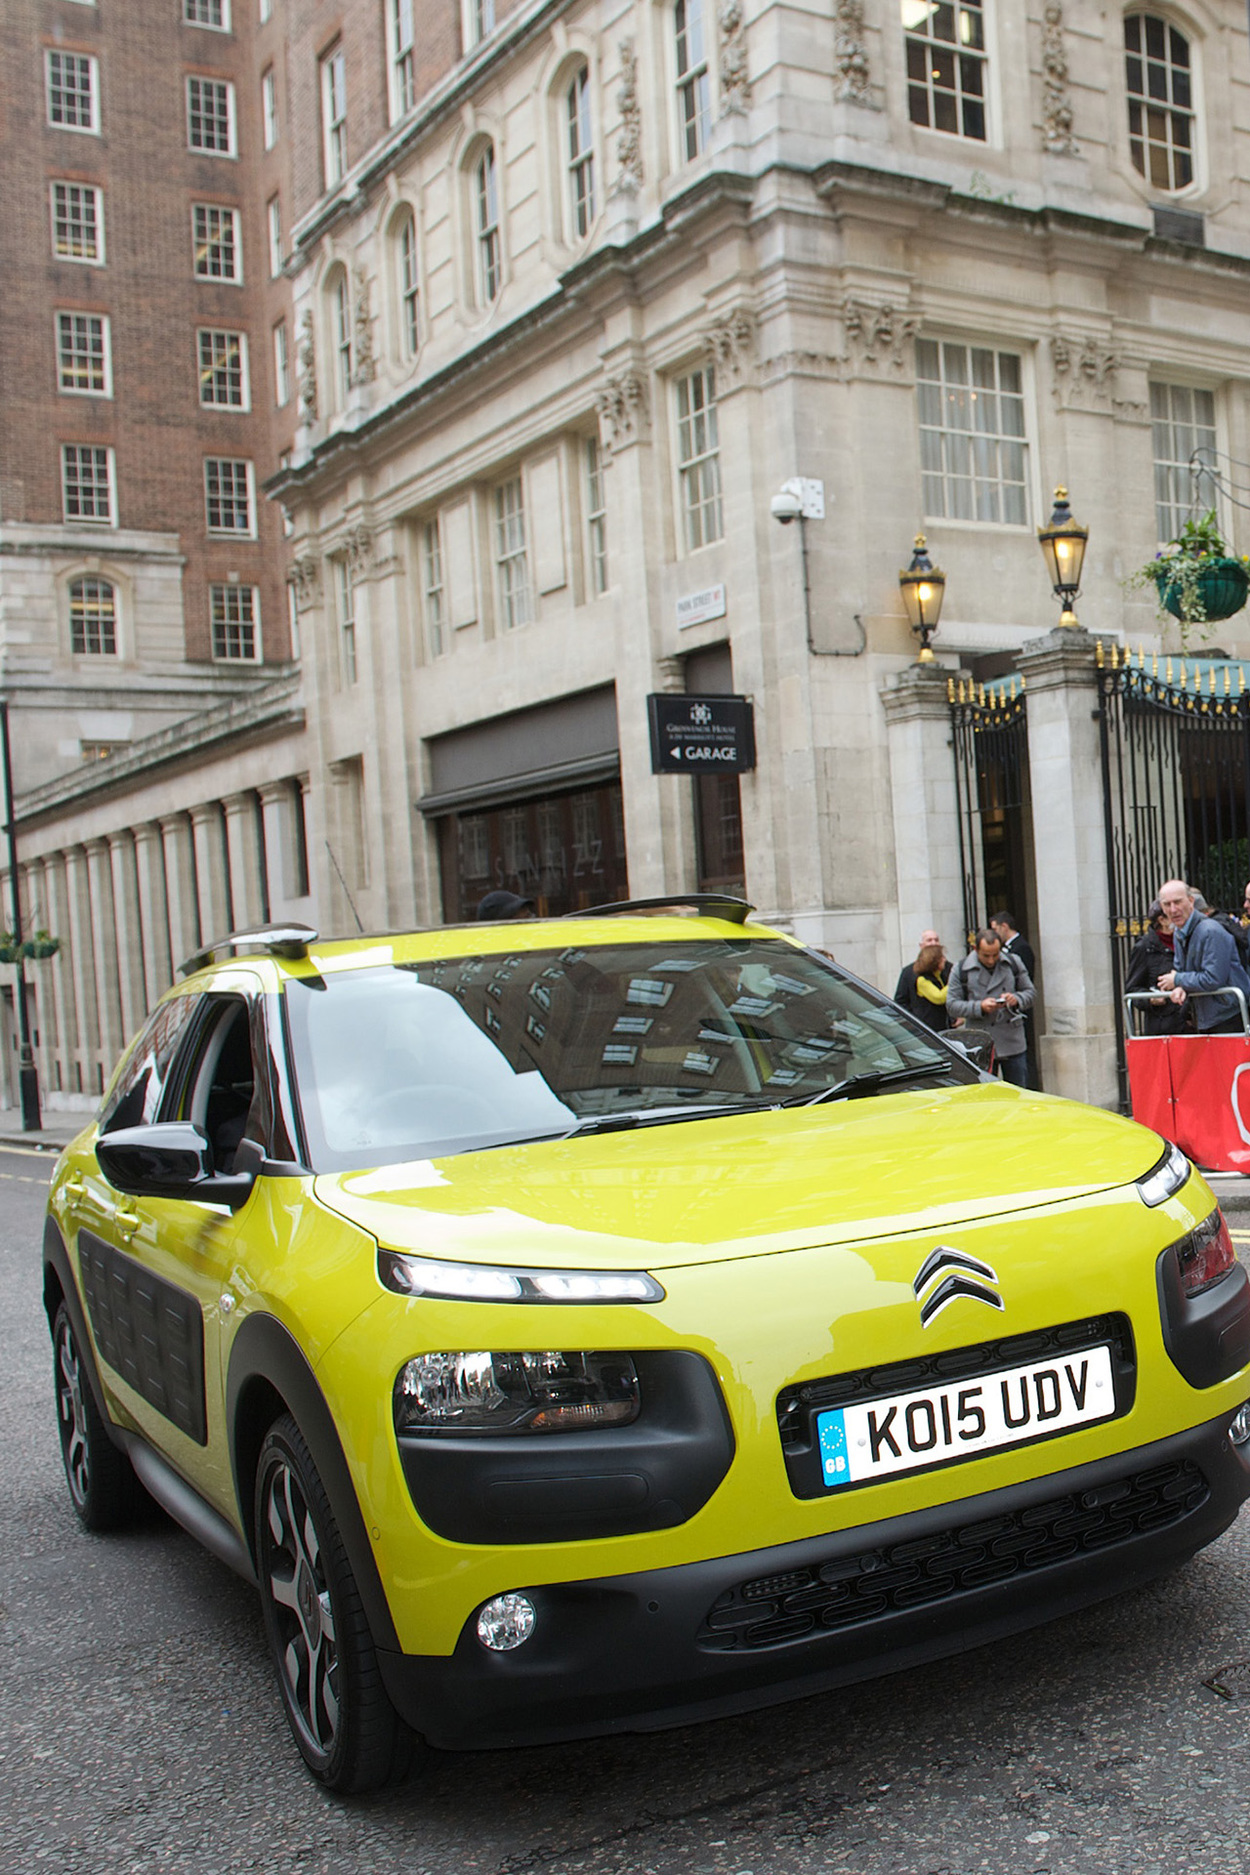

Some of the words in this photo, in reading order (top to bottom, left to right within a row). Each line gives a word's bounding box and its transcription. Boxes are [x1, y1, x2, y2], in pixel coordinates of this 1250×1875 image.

[685, 746, 737, 761] GARAGE
[867, 1386, 987, 1463] KO15
[1001, 1360, 1089, 1429] UDV
[825, 1456, 847, 1474] GB
